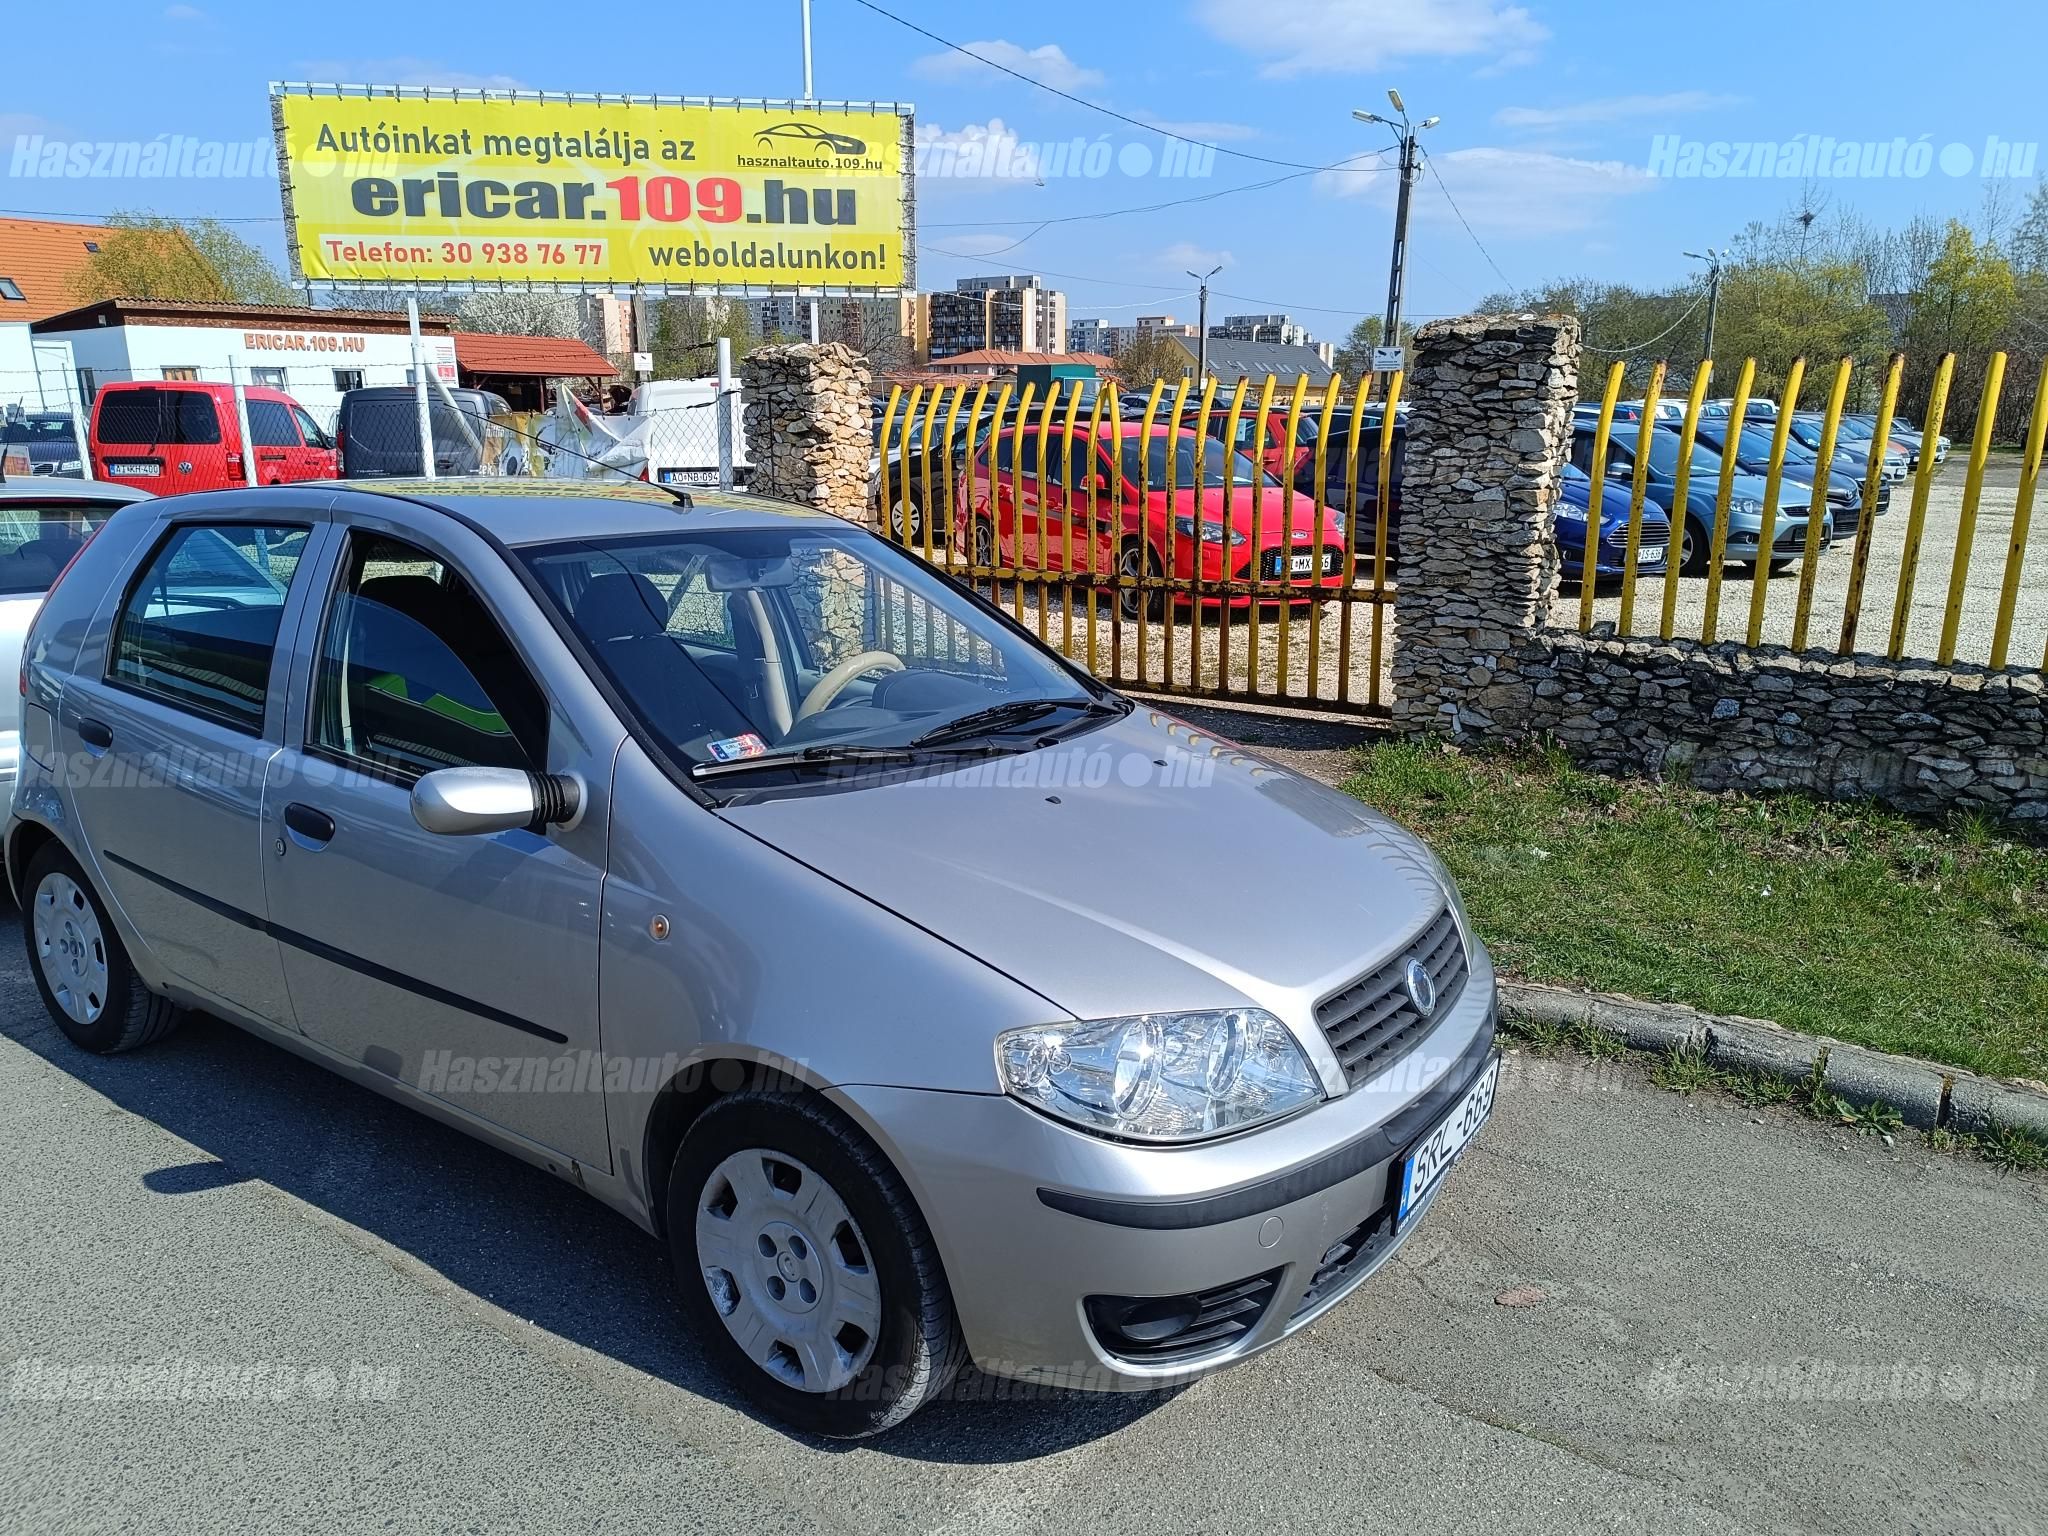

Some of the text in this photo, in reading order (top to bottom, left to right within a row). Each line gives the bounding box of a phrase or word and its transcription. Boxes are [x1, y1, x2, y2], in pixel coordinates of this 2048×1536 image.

[316, 121, 696, 165] Autóinkat megtalálja az
[737, 155, 883, 170] hasznaltauto.109.hu
[351, 172, 857, 225] ericar.109.hu
[326, 240, 602, 265] Telefon: 30 938 76 77
[648, 241, 886, 270] weboldalunkon!
[244, 333, 365, 352] ERICAR.109.HU
[1414, 1070, 1494, 1195] SRL-669
